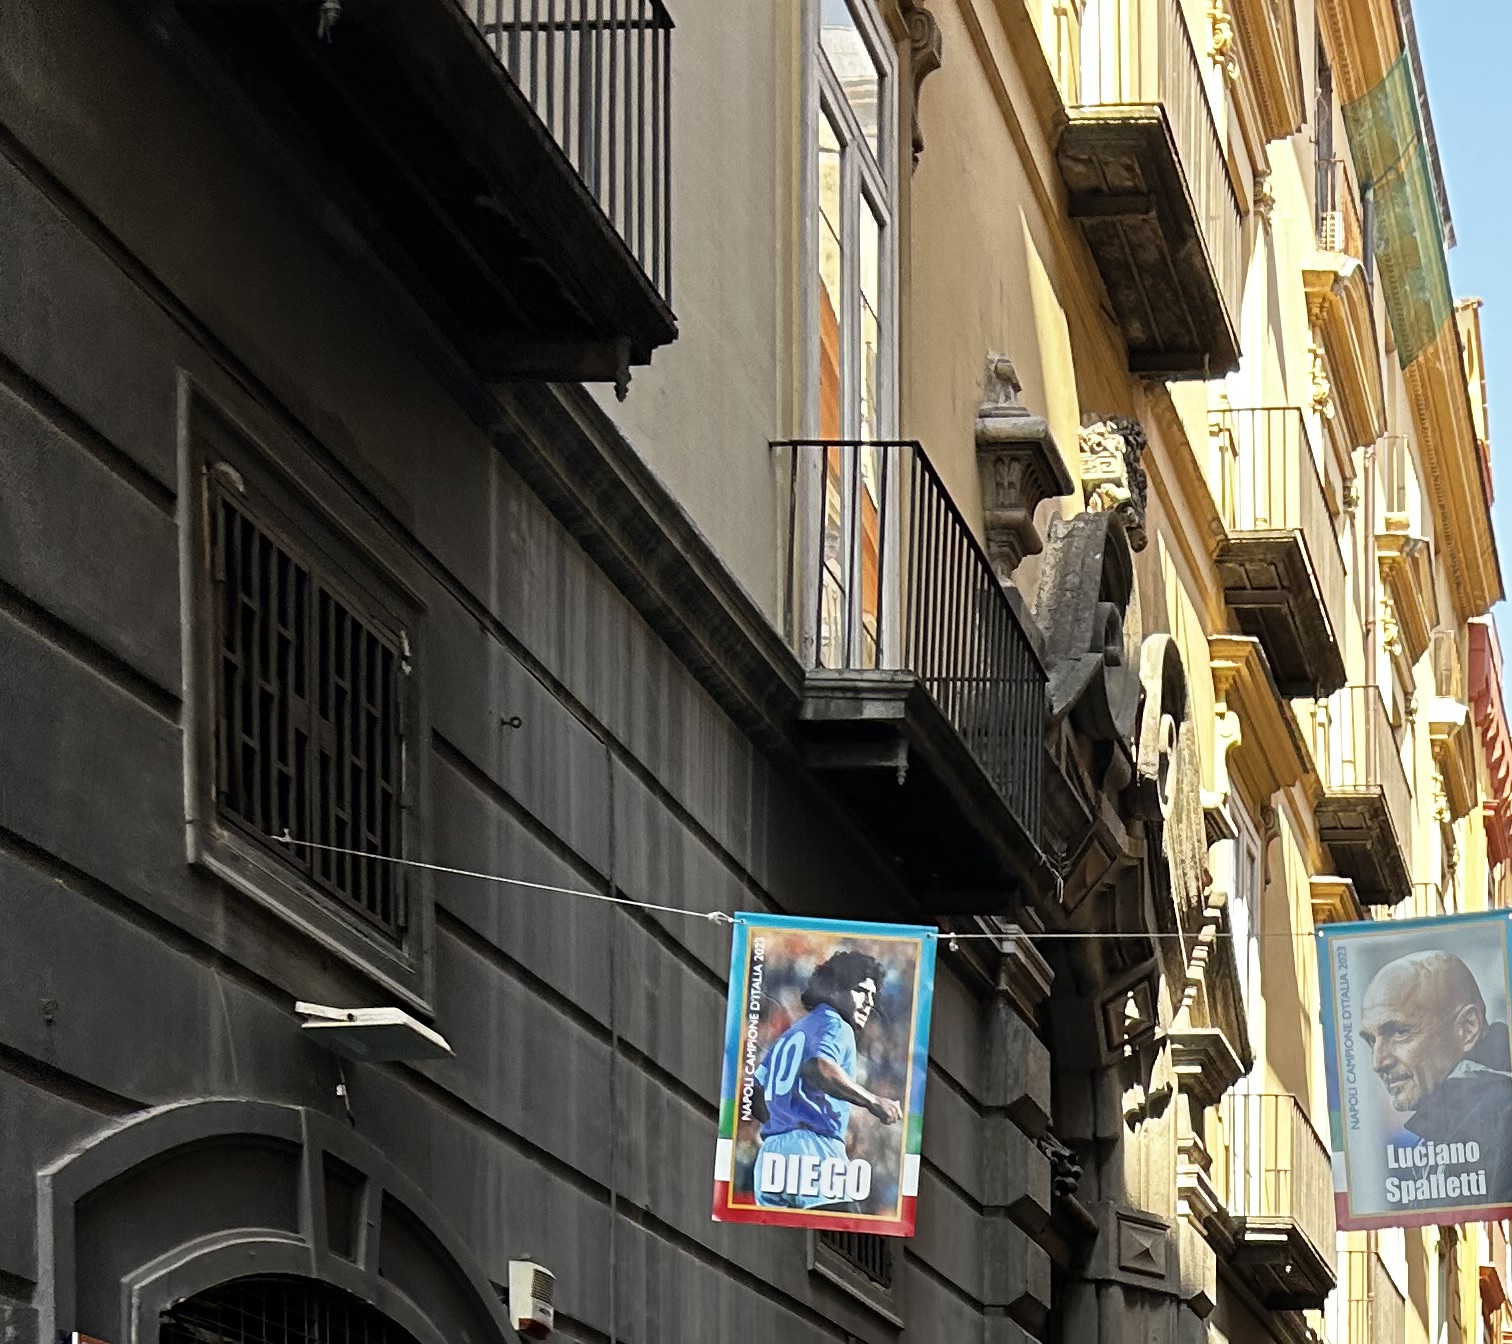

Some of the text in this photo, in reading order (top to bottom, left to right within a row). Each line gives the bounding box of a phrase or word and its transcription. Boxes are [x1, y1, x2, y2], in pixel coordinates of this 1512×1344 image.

[741, 936, 767, 1121] NAPOLI CAMPIONE D'ITALIA 2023
[1336, 945, 1361, 1130] NAPOLI CAMPIONE D'ITALIA 2023
[760, 1152, 872, 1201] DIEGO
[1386, 1139, 1480, 1170] Luciano
[1385, 1170, 1487, 1204] Spalletti
